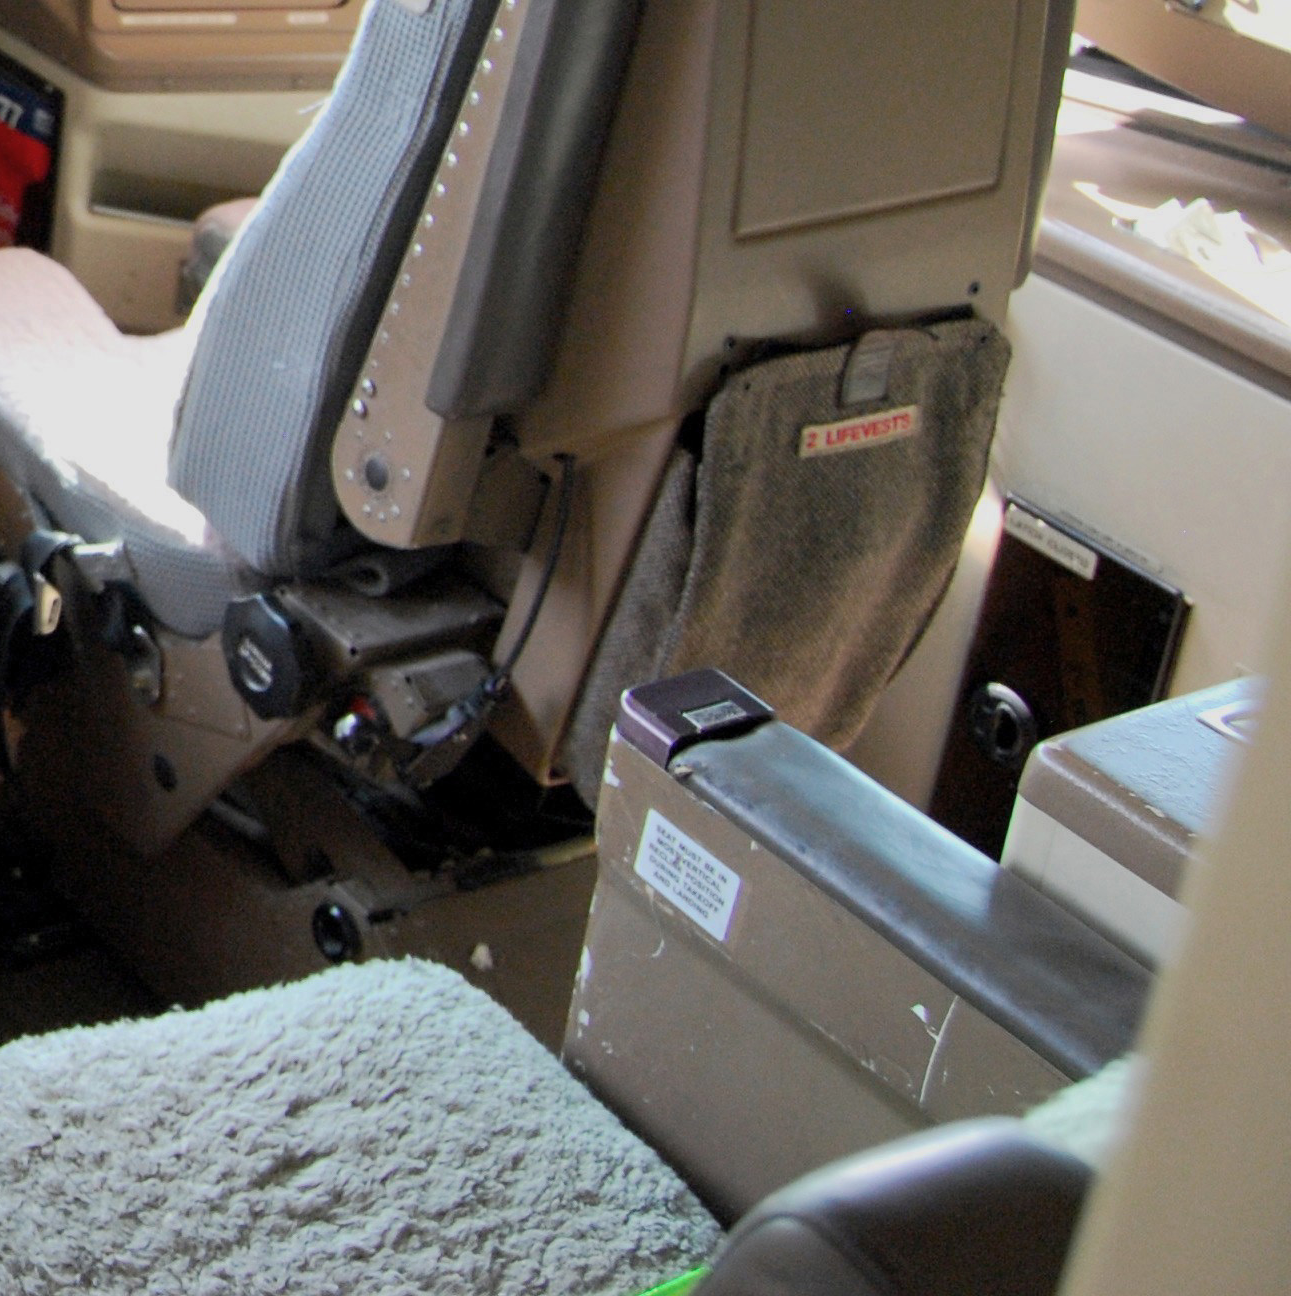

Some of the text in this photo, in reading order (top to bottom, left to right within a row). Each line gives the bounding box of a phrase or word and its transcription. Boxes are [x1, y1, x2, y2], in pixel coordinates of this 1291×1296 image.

[806, 412, 912, 449] 2 LIFEVESTS
[656, 824, 677, 844] SEAT
[678, 842, 702, 864] MUST
[648, 854, 719, 913] DURING TAKEOFF
[682, 858, 722, 893] VERTICAL
[685, 872, 725, 907] POSITION
[653, 870, 709, 920] AND LANDING
